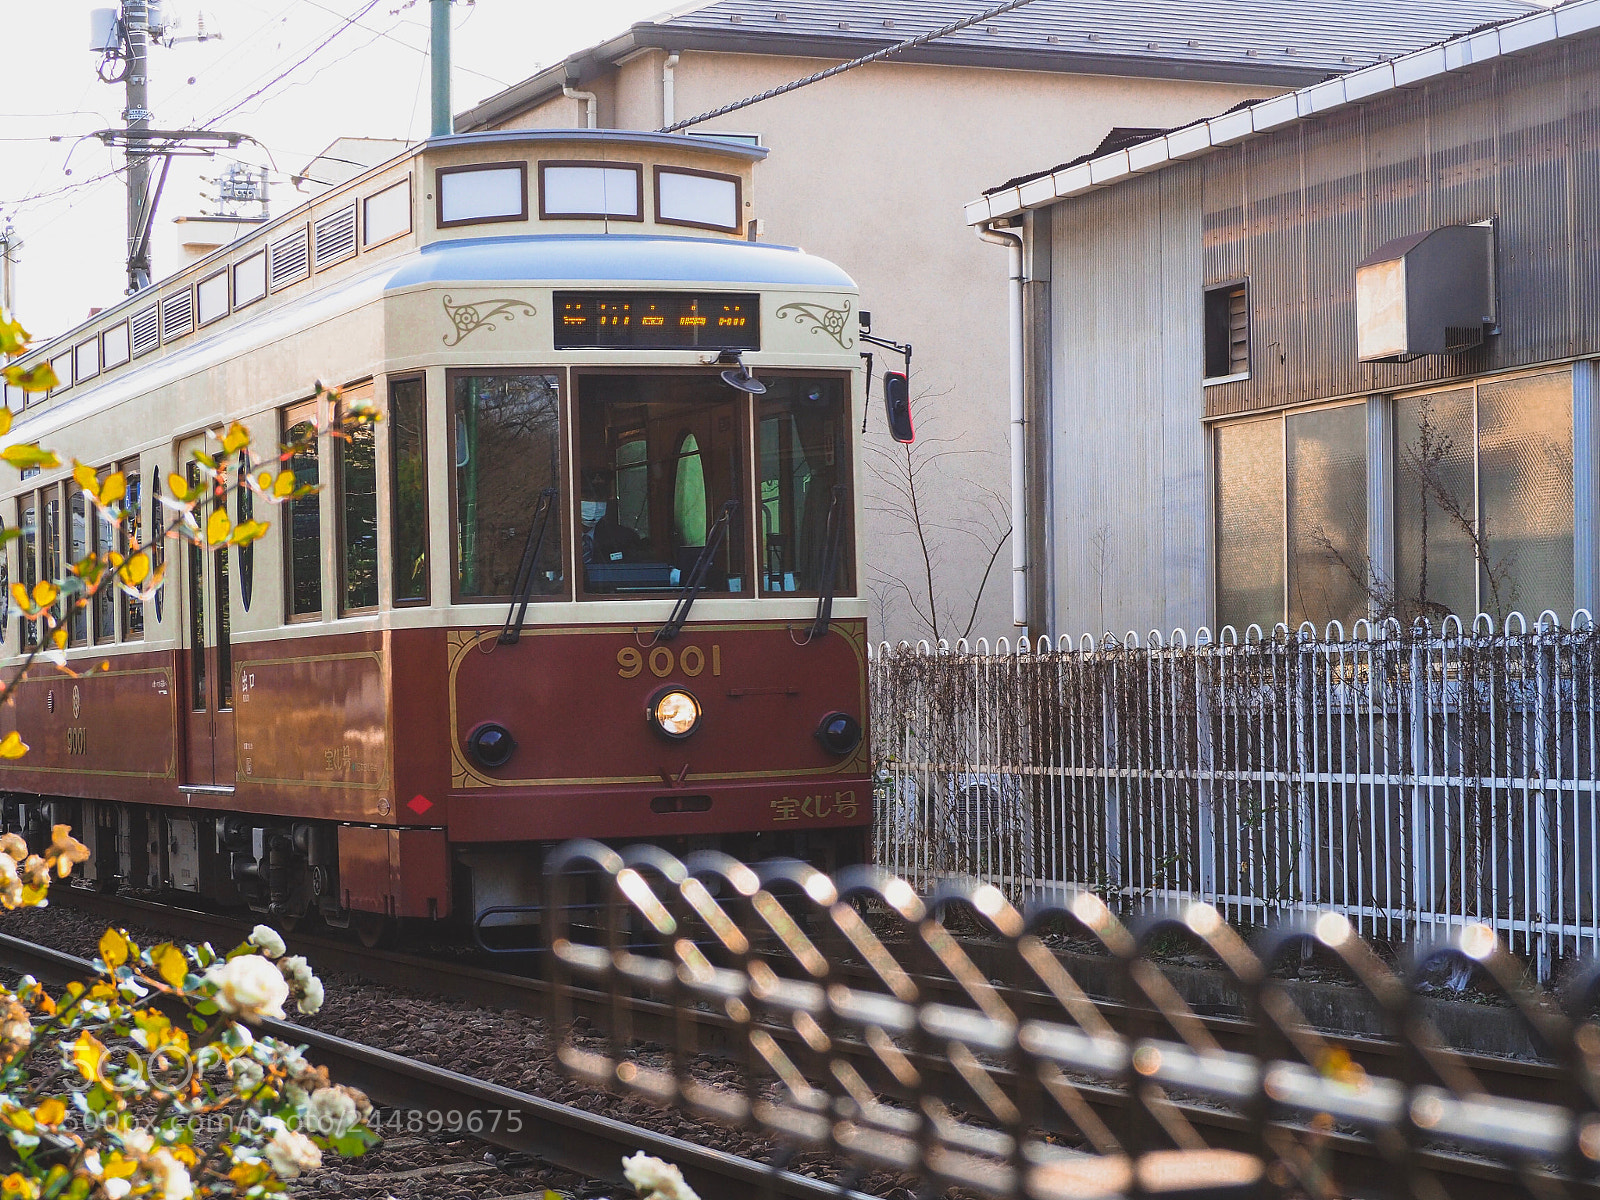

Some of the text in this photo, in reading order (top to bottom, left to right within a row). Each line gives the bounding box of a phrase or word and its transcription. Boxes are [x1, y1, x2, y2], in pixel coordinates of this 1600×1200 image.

[616, 644, 721, 679] 9001
[67, 727, 87, 755] 9001
[769, 790, 860, 821] 宝くじ号
